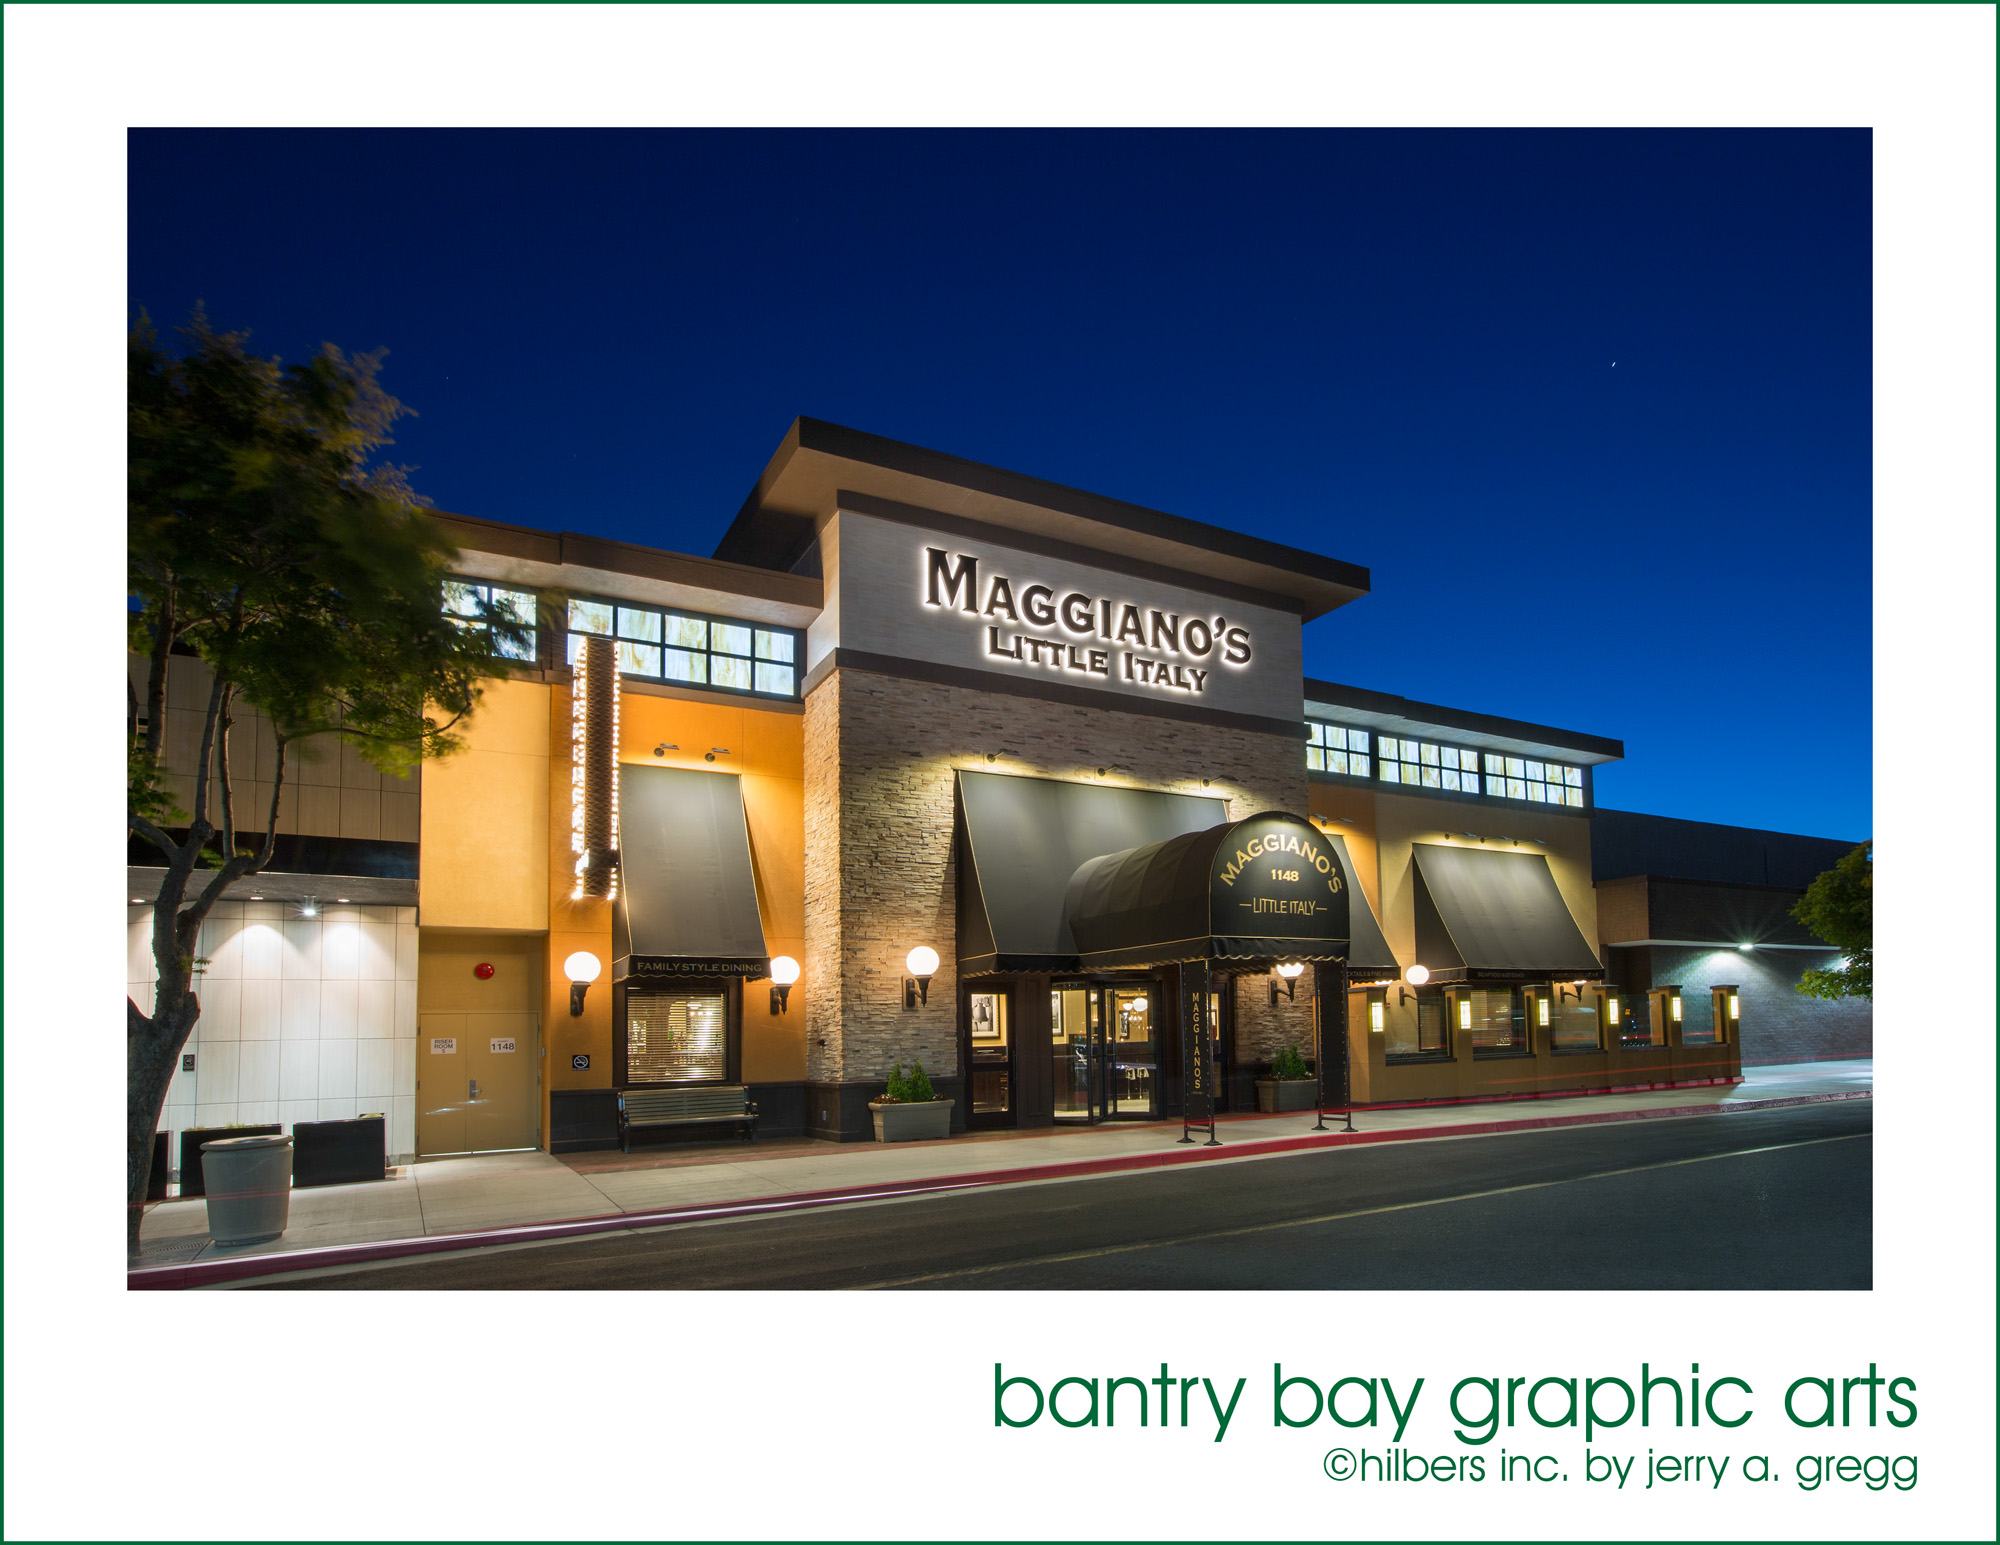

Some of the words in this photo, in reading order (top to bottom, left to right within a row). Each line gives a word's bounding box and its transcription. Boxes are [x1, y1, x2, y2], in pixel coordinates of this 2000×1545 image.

[925, 547, 1251, 664] MAGGIANO'S
[987, 626, 1109, 676] LITTLE
[1123, 652, 1208, 692] ITALY
[1220, 834, 1343, 894] MAGGIANO'S
[1271, 869, 1300, 882] 1148
[1253, 897, 1288, 914] LITTLE
[1289, 900, 1316, 916] ITALY
[637, 962, 680, 972] FAMILY
[682, 963, 719, 972] STYLE
[721, 963, 762, 973] DINING
[491, 1042, 515, 1051] 1148
